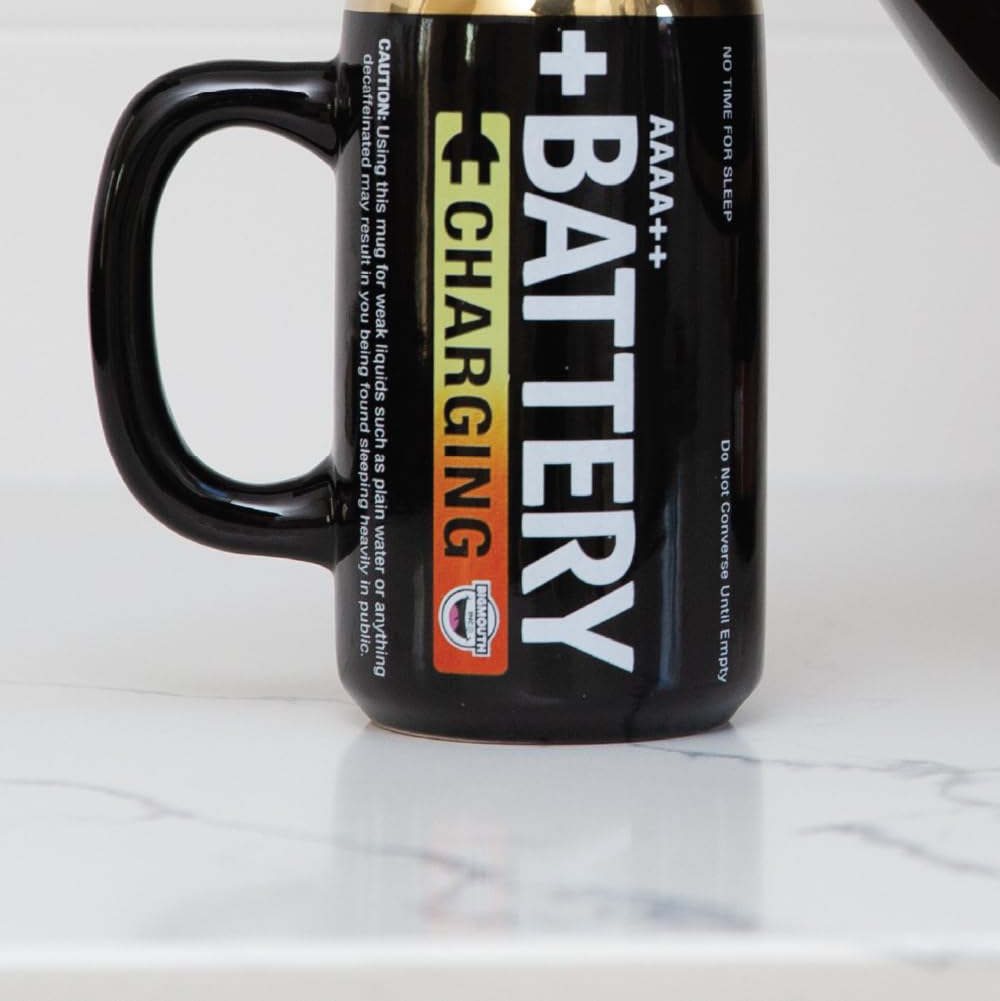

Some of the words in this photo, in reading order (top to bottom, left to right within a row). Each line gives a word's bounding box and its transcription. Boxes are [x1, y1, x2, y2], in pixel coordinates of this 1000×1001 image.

[377, 38, 391, 121] CAUTION:
[722, 46, 733, 72] NO
[361, 53, 373, 168] decaffeinated
[722, 78, 733, 120] TIME
[374, 125, 390, 176] Using
[722, 125, 733, 161] FOR
[359, 173, 371, 211] may
[375, 181, 390, 213] this
[649, 114, 675, 269] AAAA++
[722, 166, 733, 222] SLEEP
[360, 216, 372, 265] result
[373, 218, 388, 259] mug
[360, 270, 372, 285] in
[375, 264, 390, 288] for
[358, 291, 370, 323] you
[374, 293, 388, 338] weak
[357, 330, 371, 377] being
[372, 343, 388, 402] liquids
[444, 201, 494, 558] CHARGING
[521, 115, 639, 673] BATTERY
[359, 382, 371, 433] found
[374, 406, 388, 449] such
[358, 438, 371, 509] sleeping
[374, 453, 386, 473] as
[720, 439, 731, 462] Do
[372, 478, 388, 520] plain
[720, 467, 730, 497] Not
[358, 515, 371, 574] heavily
[374, 524, 386, 574] water
[720, 502, 731, 580] Converse
[359, 579, 371, 596] in
[374, 578, 386, 598] or
[719, 585, 730, 623] Until
[358, 601, 371, 657] public.
[373, 602, 389, 678] anything
[476, 586, 488, 654] BIGMOUTH
[717, 628, 731, 683] Empty
